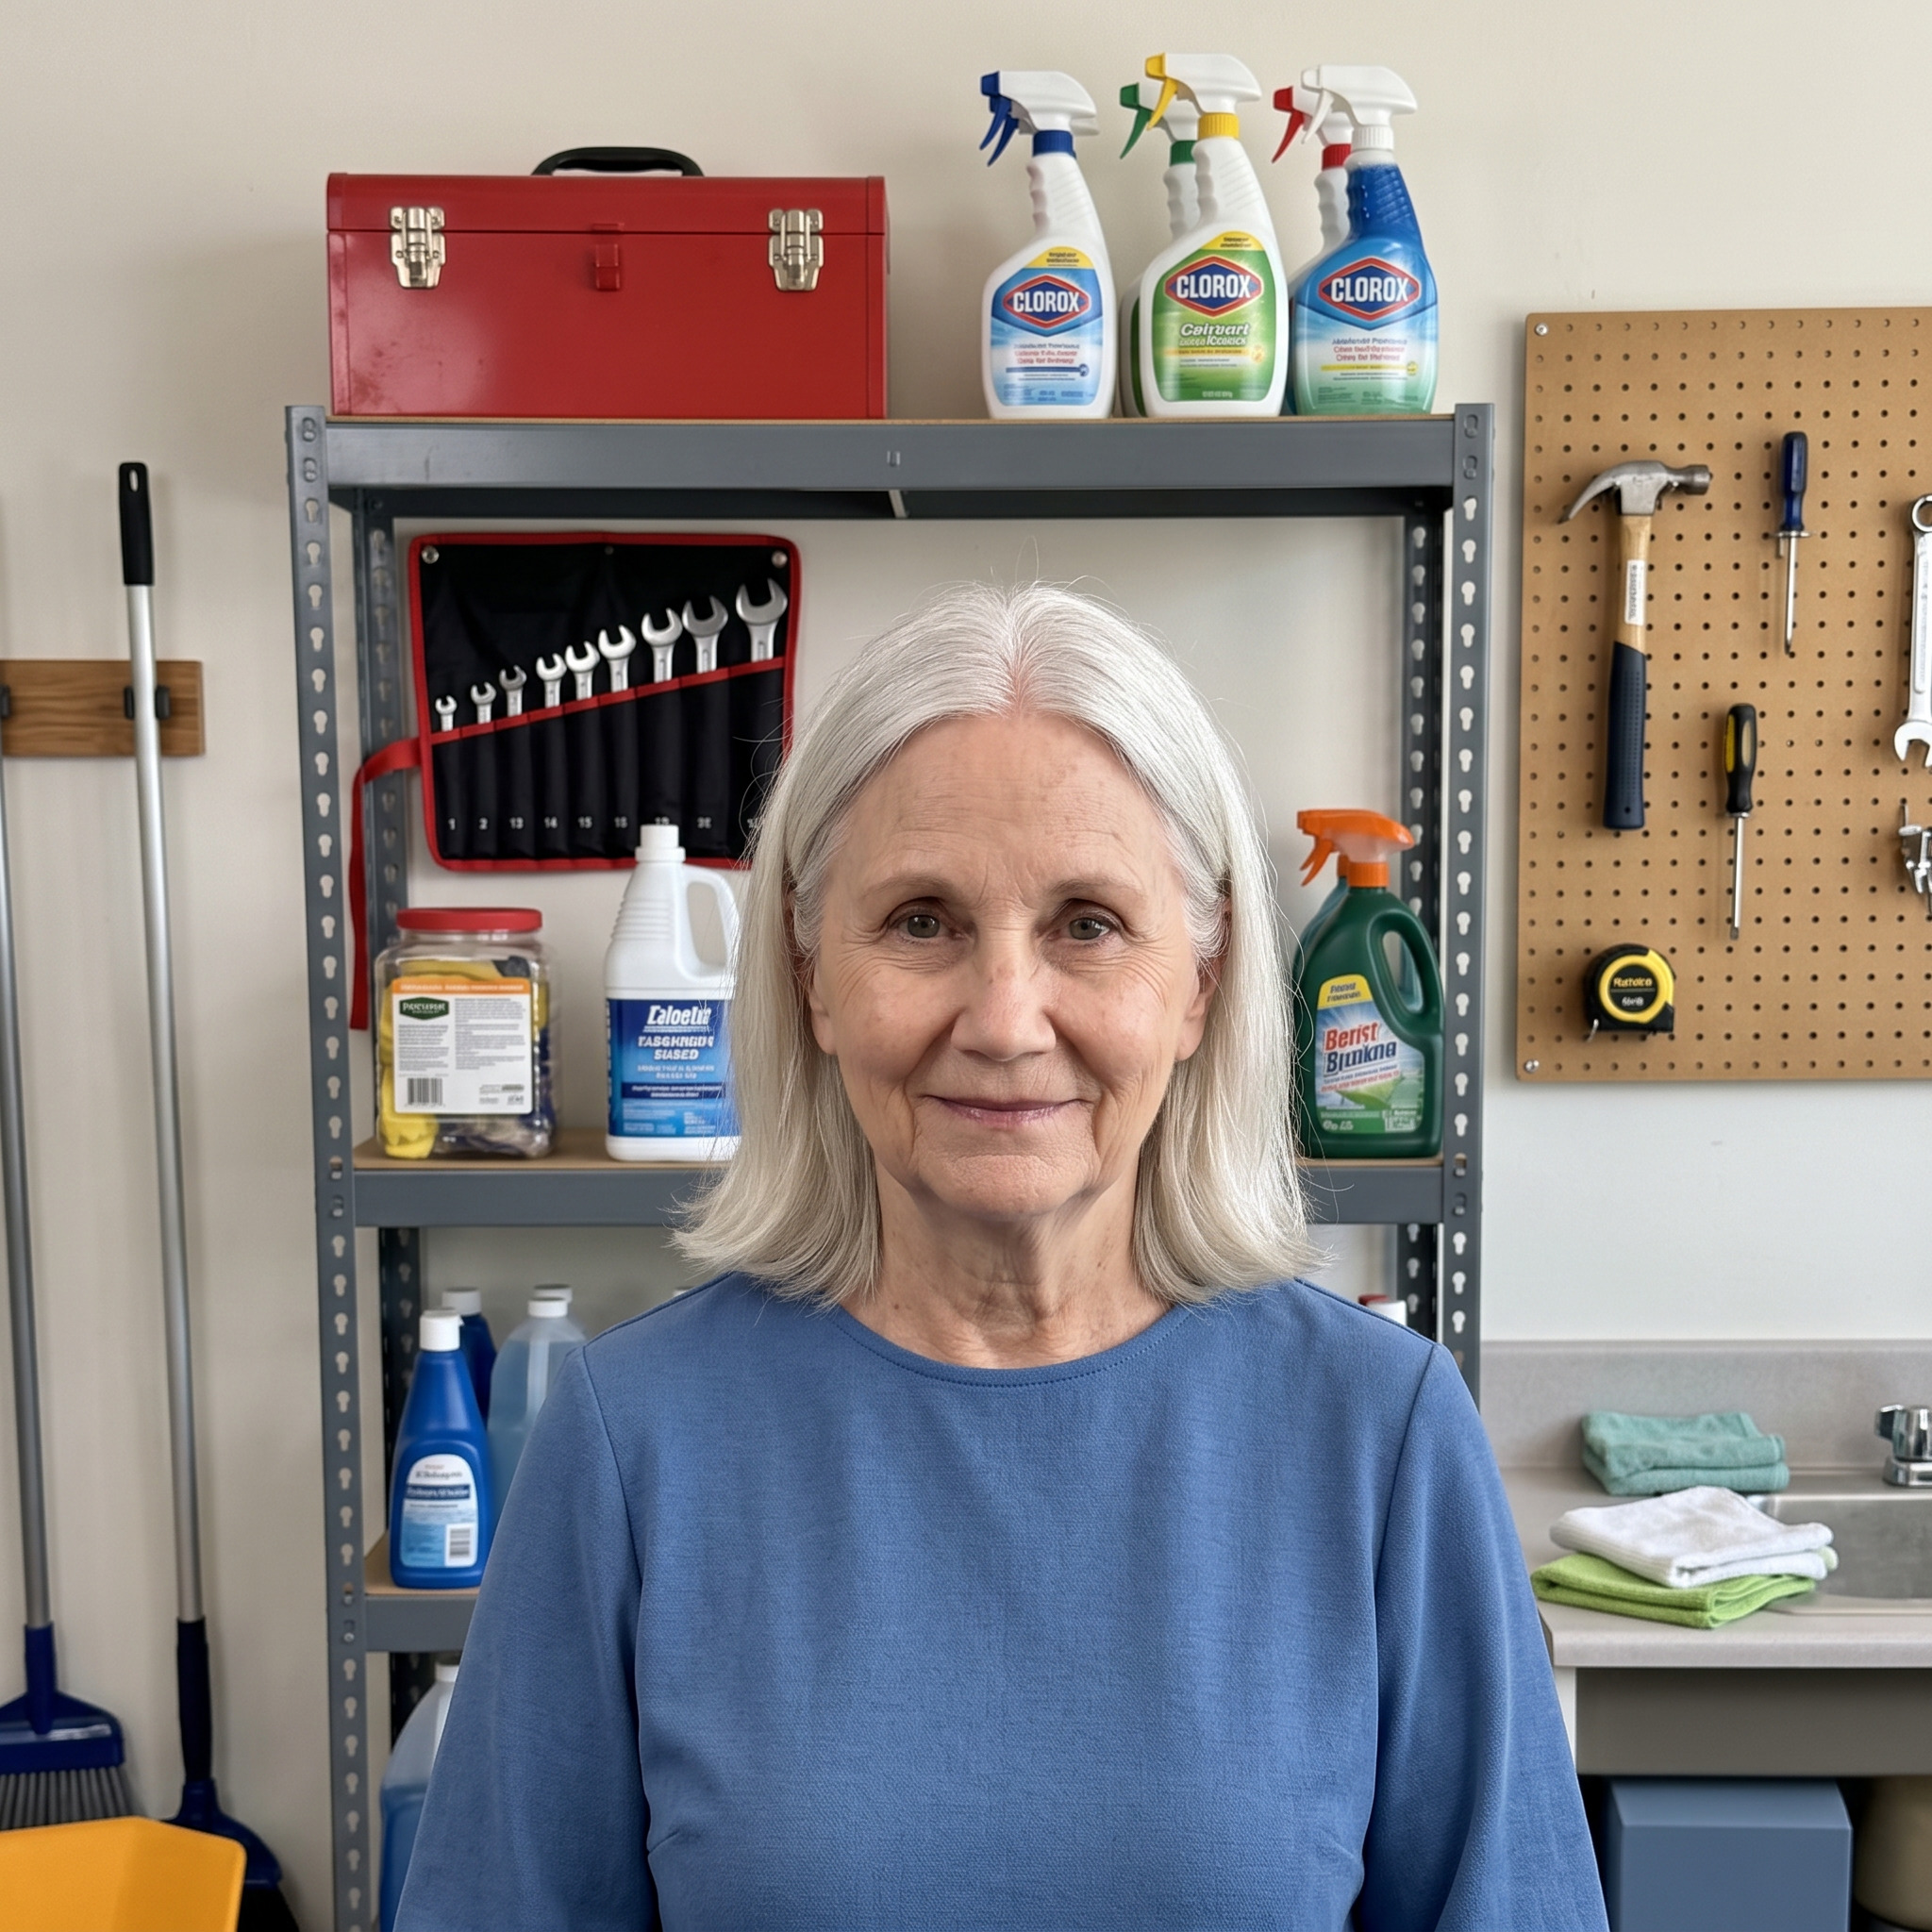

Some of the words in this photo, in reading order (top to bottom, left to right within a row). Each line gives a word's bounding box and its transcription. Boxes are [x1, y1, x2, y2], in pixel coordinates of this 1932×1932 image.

[1176, 274, 1251, 299] CLOROX
[1330, 275, 1408, 303] CLOROX
[1013, 291, 1080, 312] CLOROX
[479, 817, 488, 830] 2
